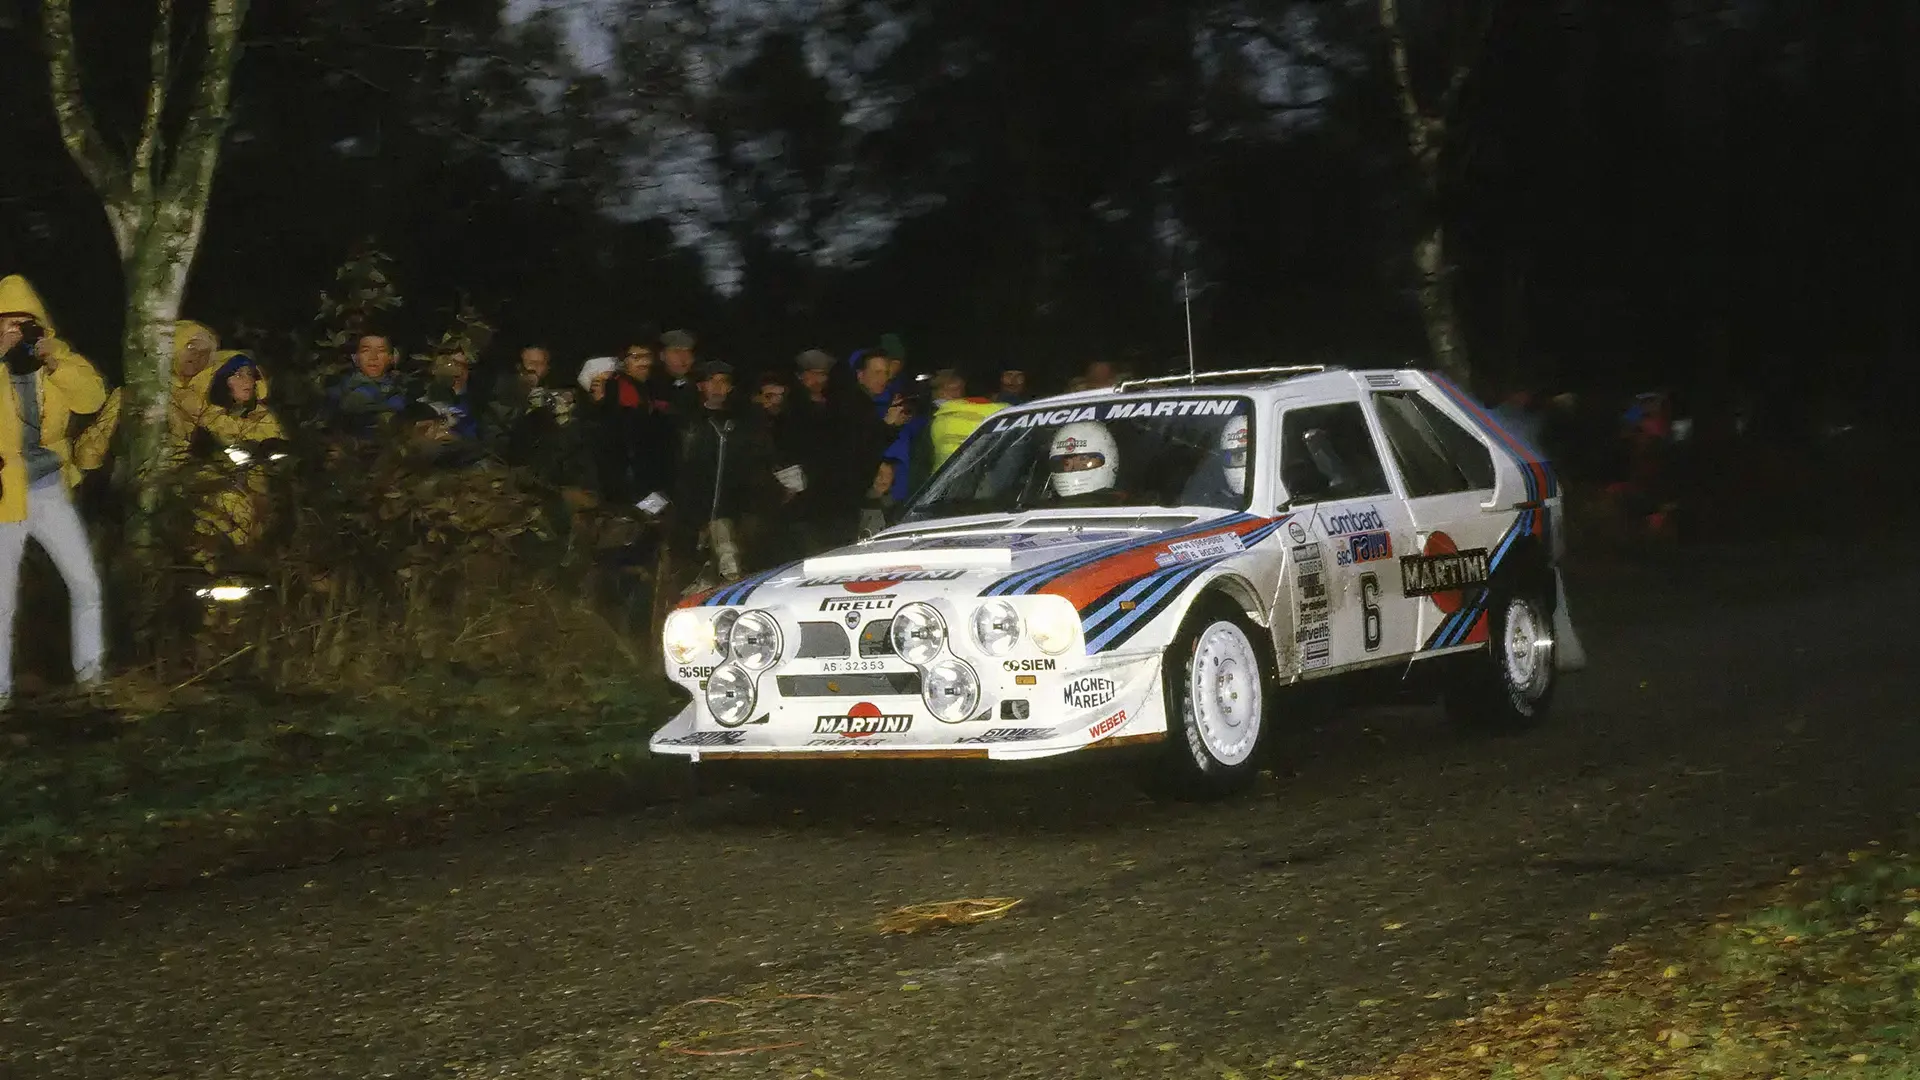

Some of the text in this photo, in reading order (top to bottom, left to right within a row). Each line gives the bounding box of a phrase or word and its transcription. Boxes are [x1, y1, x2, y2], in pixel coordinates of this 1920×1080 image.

[992, 399, 1239, 432] LANCIA MARTINI
[1317, 504, 1384, 535] Lombard
[1403, 555, 1487, 590] MARTINI
[819, 594, 897, 612] PIRELLI
[1359, 571, 1380, 652] 6
[1022, 658, 1056, 671] SIEM
[817, 716, 909, 733] MARTINI
[1089, 710, 1127, 739] WEBER
